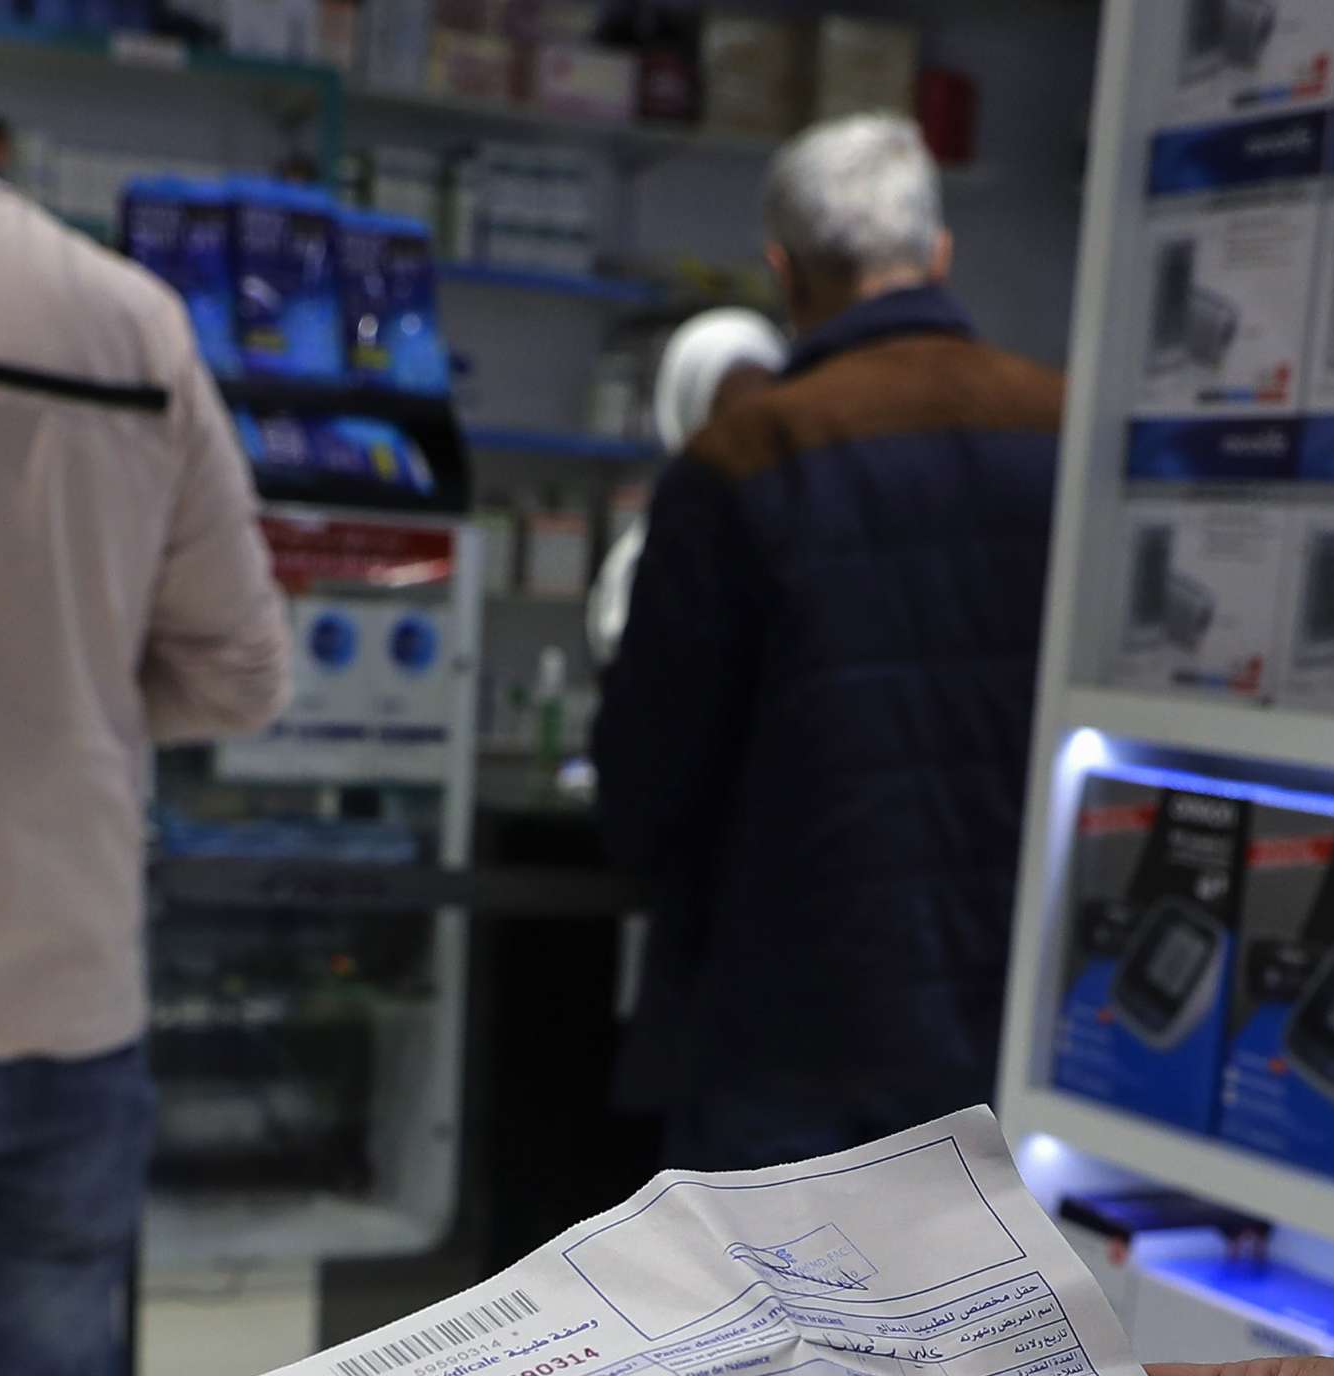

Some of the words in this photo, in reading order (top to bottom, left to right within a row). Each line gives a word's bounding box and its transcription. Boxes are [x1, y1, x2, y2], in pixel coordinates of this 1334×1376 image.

[1015, 1285, 1039, 1301] حقل
[1037, 1303, 1056, 1315] اسم
[548, 1317, 600, 1342] وصفة
[875, 1321, 909, 1336] المعالج
[913, 1313, 956, 1335] للطبيب
[997, 1310, 1036, 1332] المريض
[695, 1326, 748, 1349] destinée
[751, 1317, 768, 1330] au
[959, 1322, 997, 1344] وشهرته
[1042, 1328, 1068, 1343] تاريخ
[506, 1337, 550, 1358] طبية
[1014, 1337, 1043, 1354] ولادته
[711, 1366, 725, 1376] de
[725, 1354, 772, 1372] Naissance
[1054, 1351, 1078, 1366] المدة
